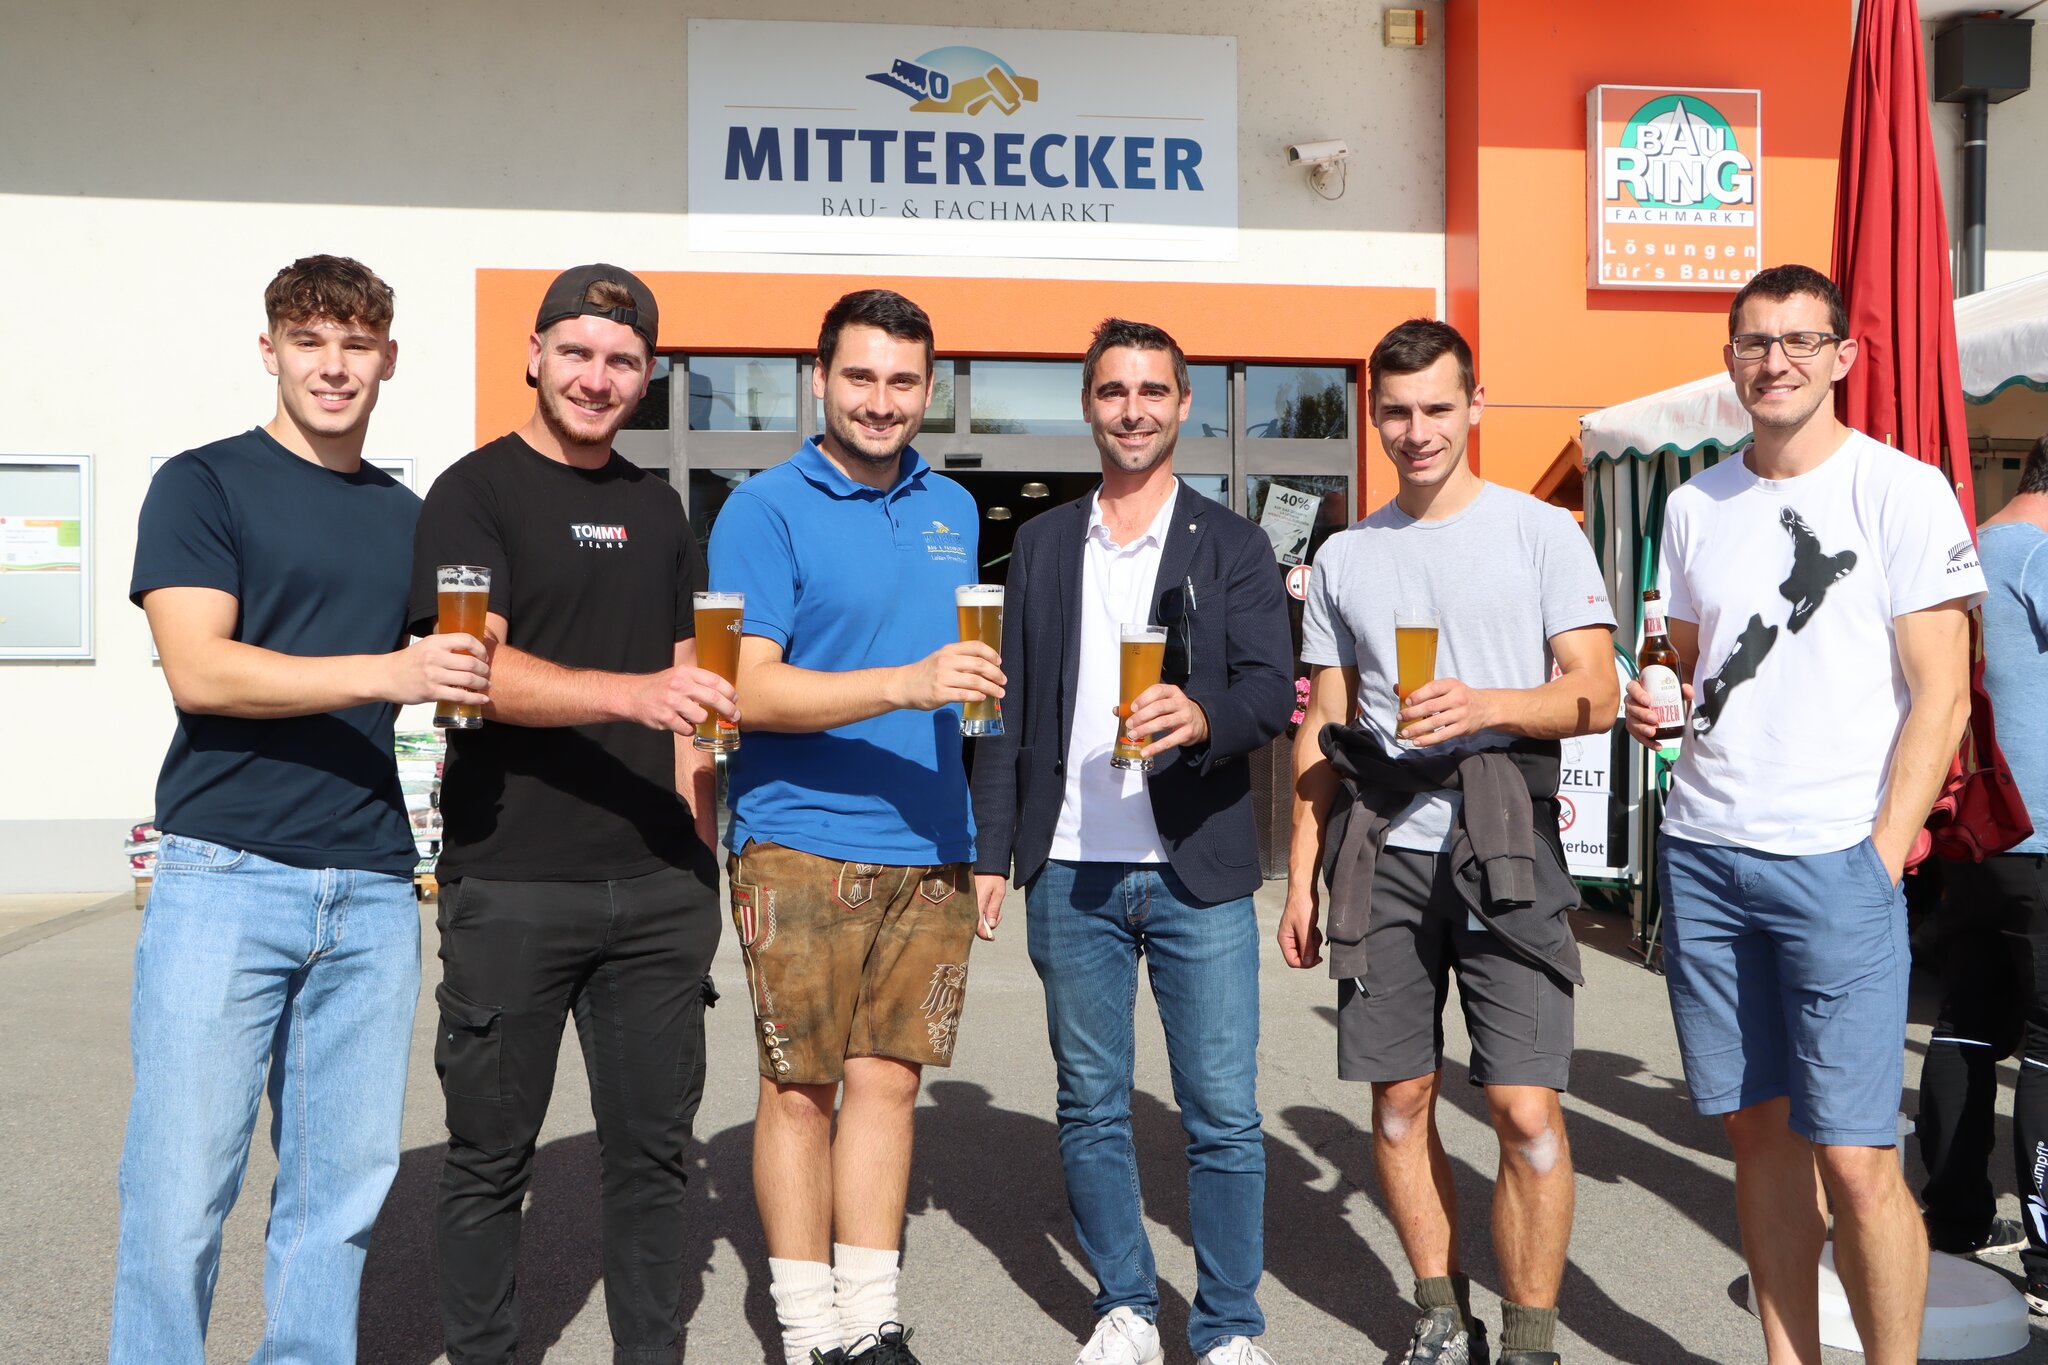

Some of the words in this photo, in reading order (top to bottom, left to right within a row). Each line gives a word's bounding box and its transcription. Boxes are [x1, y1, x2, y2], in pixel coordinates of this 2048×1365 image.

[1637, 98, 1725, 157] BAU
[724, 126, 1205, 192] MITTERECKER
[1604, 147, 1754, 205] RING
[821, 197, 889, 218] BAU-
[901, 200, 921, 219] &
[935, 200, 1116, 223] FACHMARKT
[1615, 209, 1747, 223] FACHMARKT
[1605, 238, 1757, 260] Lösungen
[1276, 493, 1310, 510] -40%
[571, 525, 622, 540] TOMMY
[579, 540, 624, 549] JEANS
[1946, 566, 1962, 575] ALL
[1650, 704, 1680, 723] RZEN
[1562, 769, 1605, 787] ZELT
